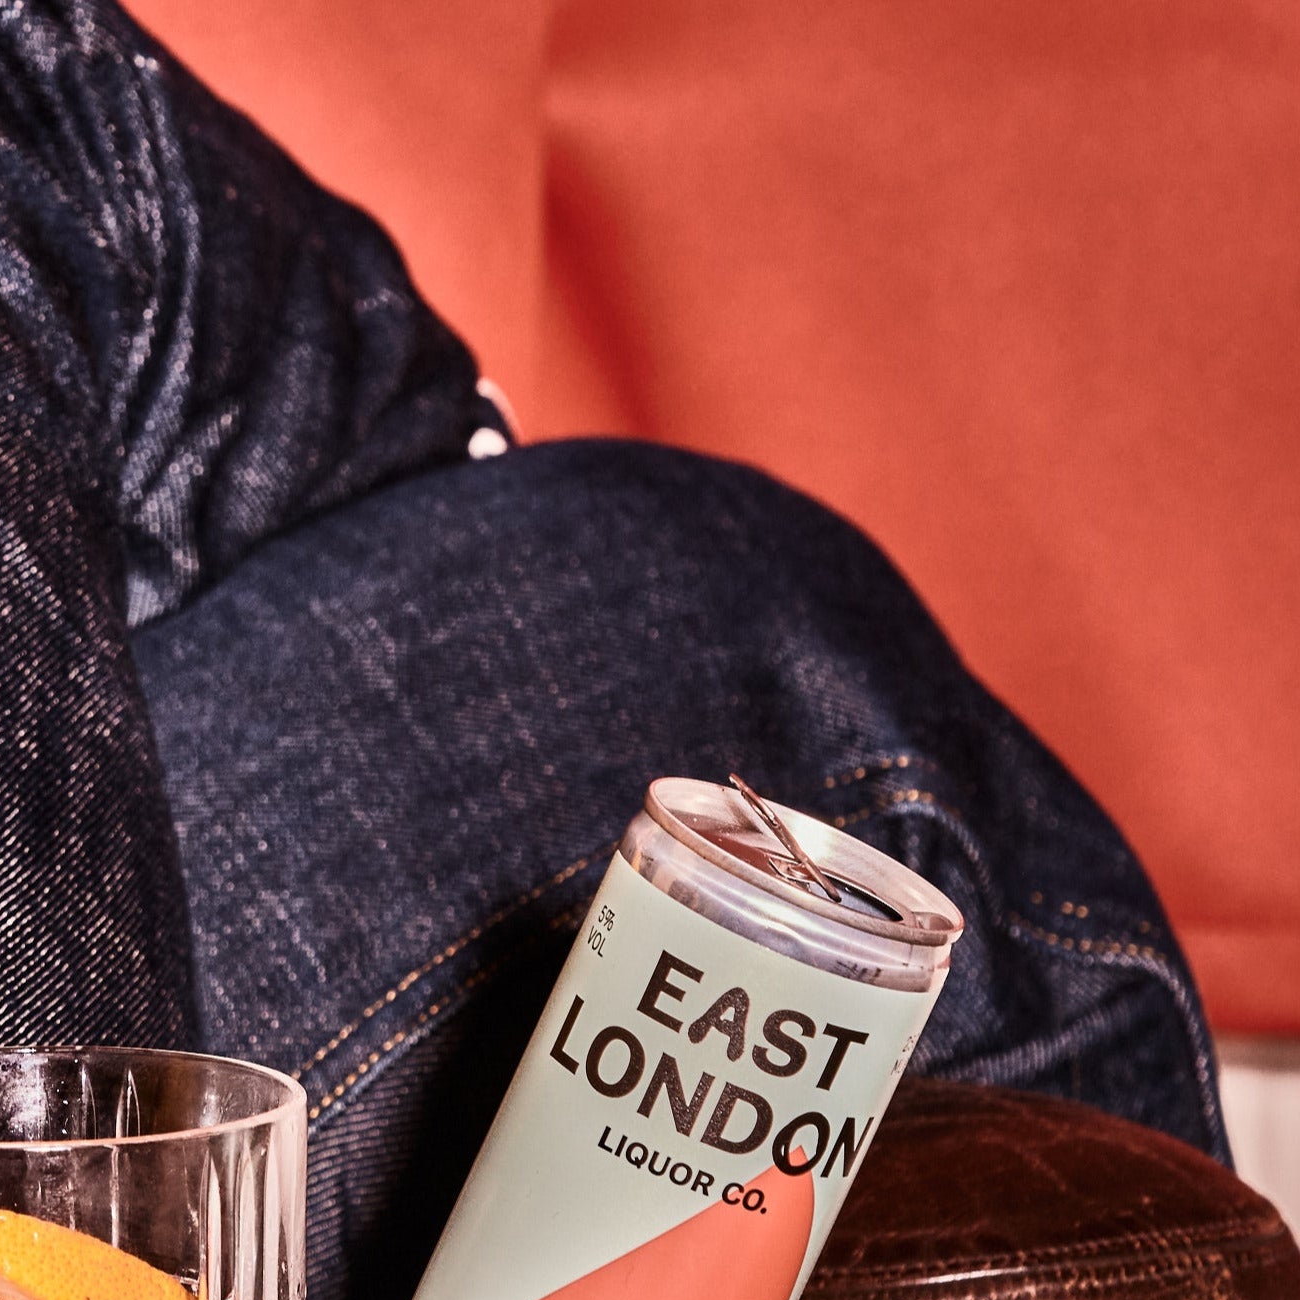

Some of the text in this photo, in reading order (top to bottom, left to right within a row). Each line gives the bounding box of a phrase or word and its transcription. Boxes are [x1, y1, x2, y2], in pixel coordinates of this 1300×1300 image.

[587, 925, 606, 958] VOL
[598, 904, 616, 932] 5%
[636, 949, 869, 1091] EAST
[549, 994, 875, 1178] LONDON
[597, 1125, 769, 1216] LIQUOR CO.
